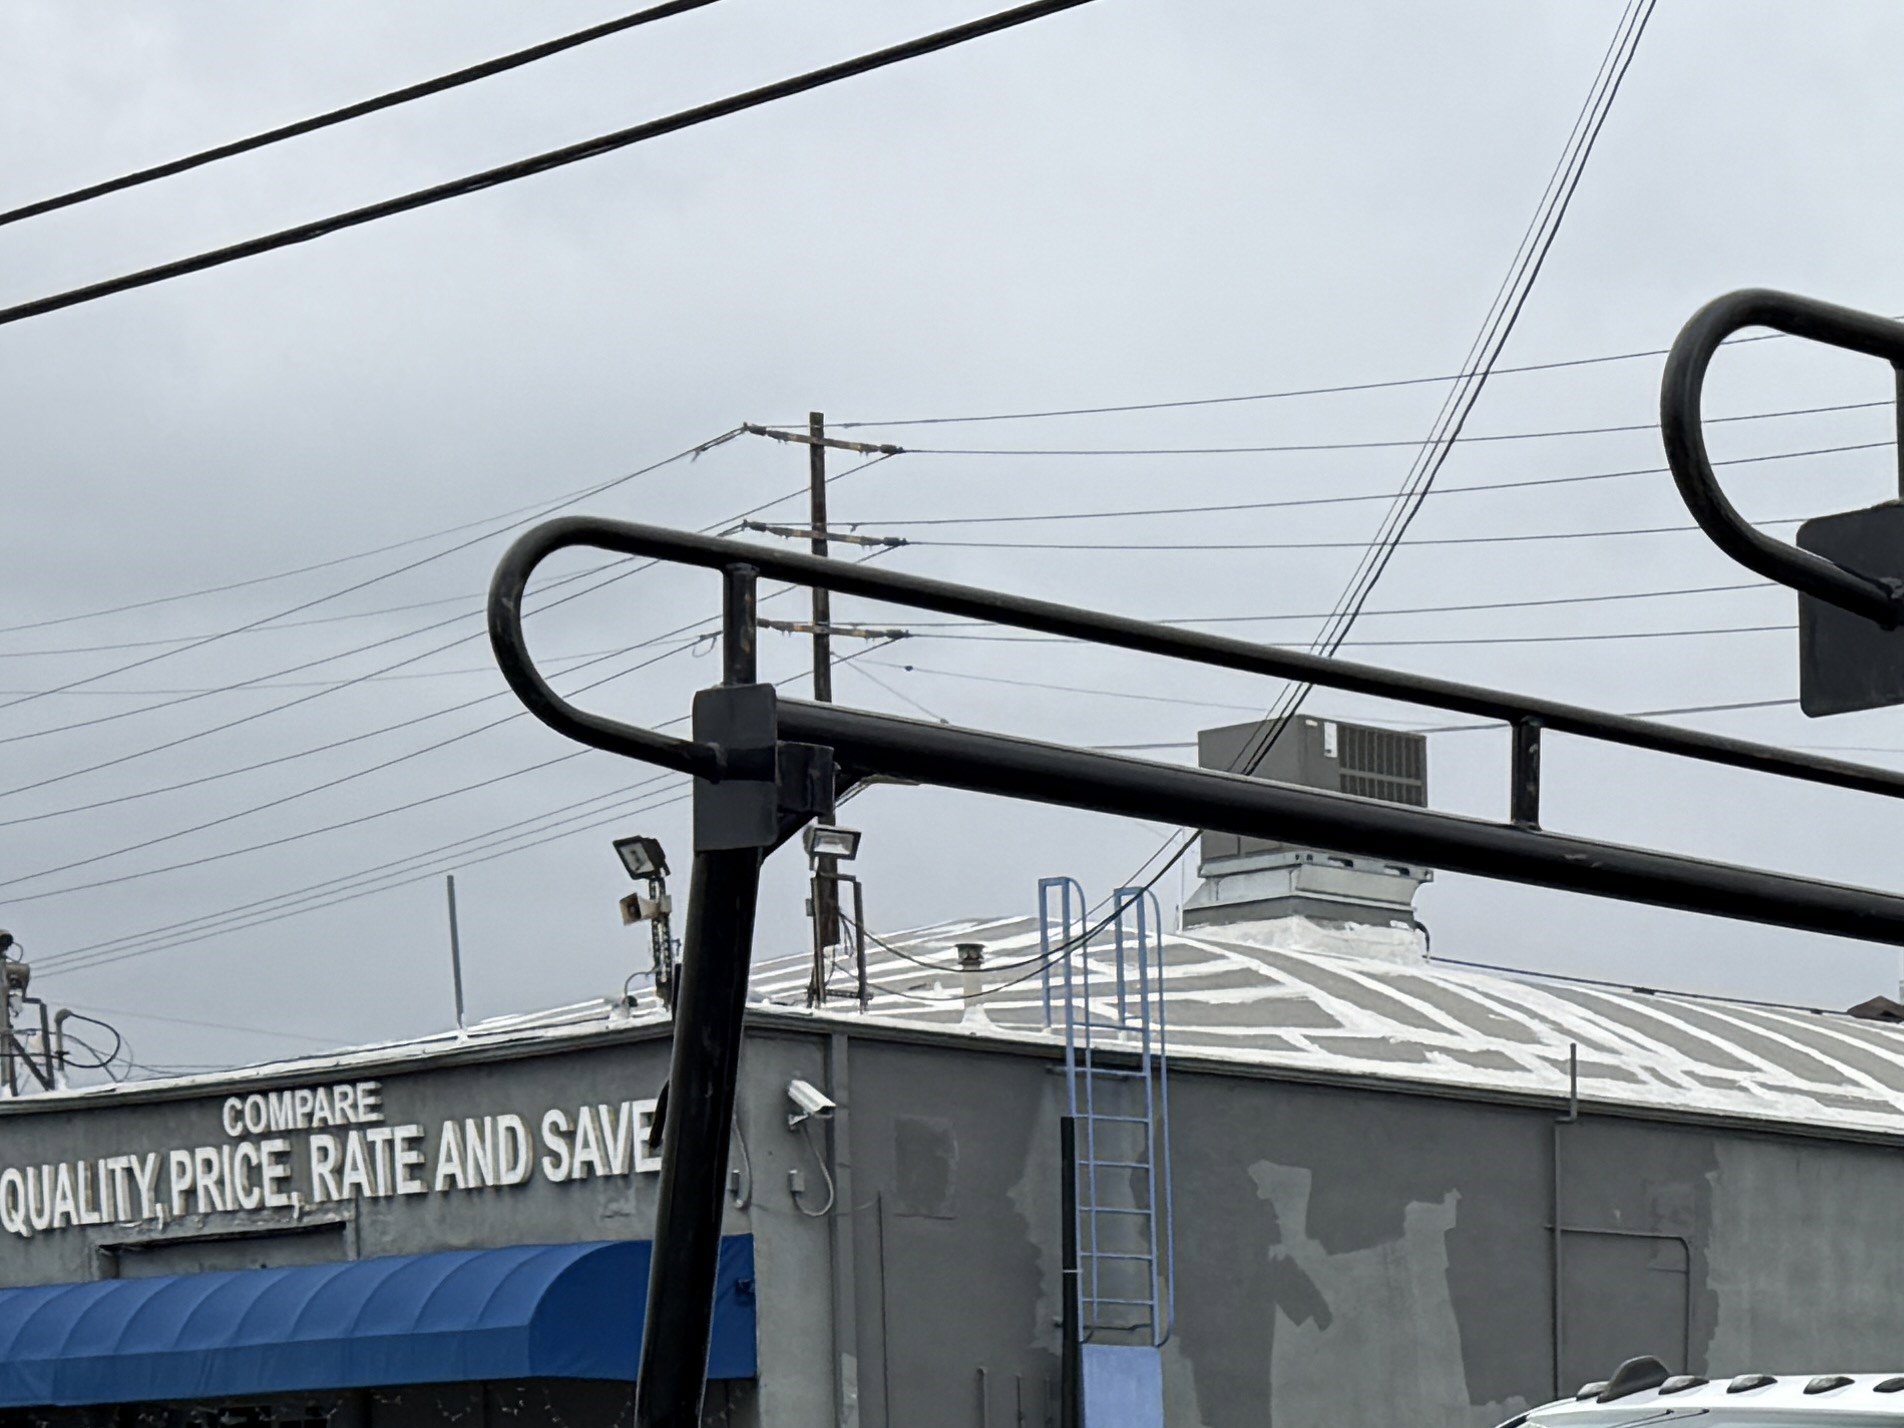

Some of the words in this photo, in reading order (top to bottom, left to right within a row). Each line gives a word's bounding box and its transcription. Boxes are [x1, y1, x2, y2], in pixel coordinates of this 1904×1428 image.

[223, 1082, 382, 1137] COMPARE
[1, 1153, 164, 1237] QUALITY,
[171, 1139, 300, 1219] PRICE,
[310, 1125, 427, 1201] RATE
[436, 1114, 533, 1191] AND
[541, 1099, 662, 1181] SAVE
